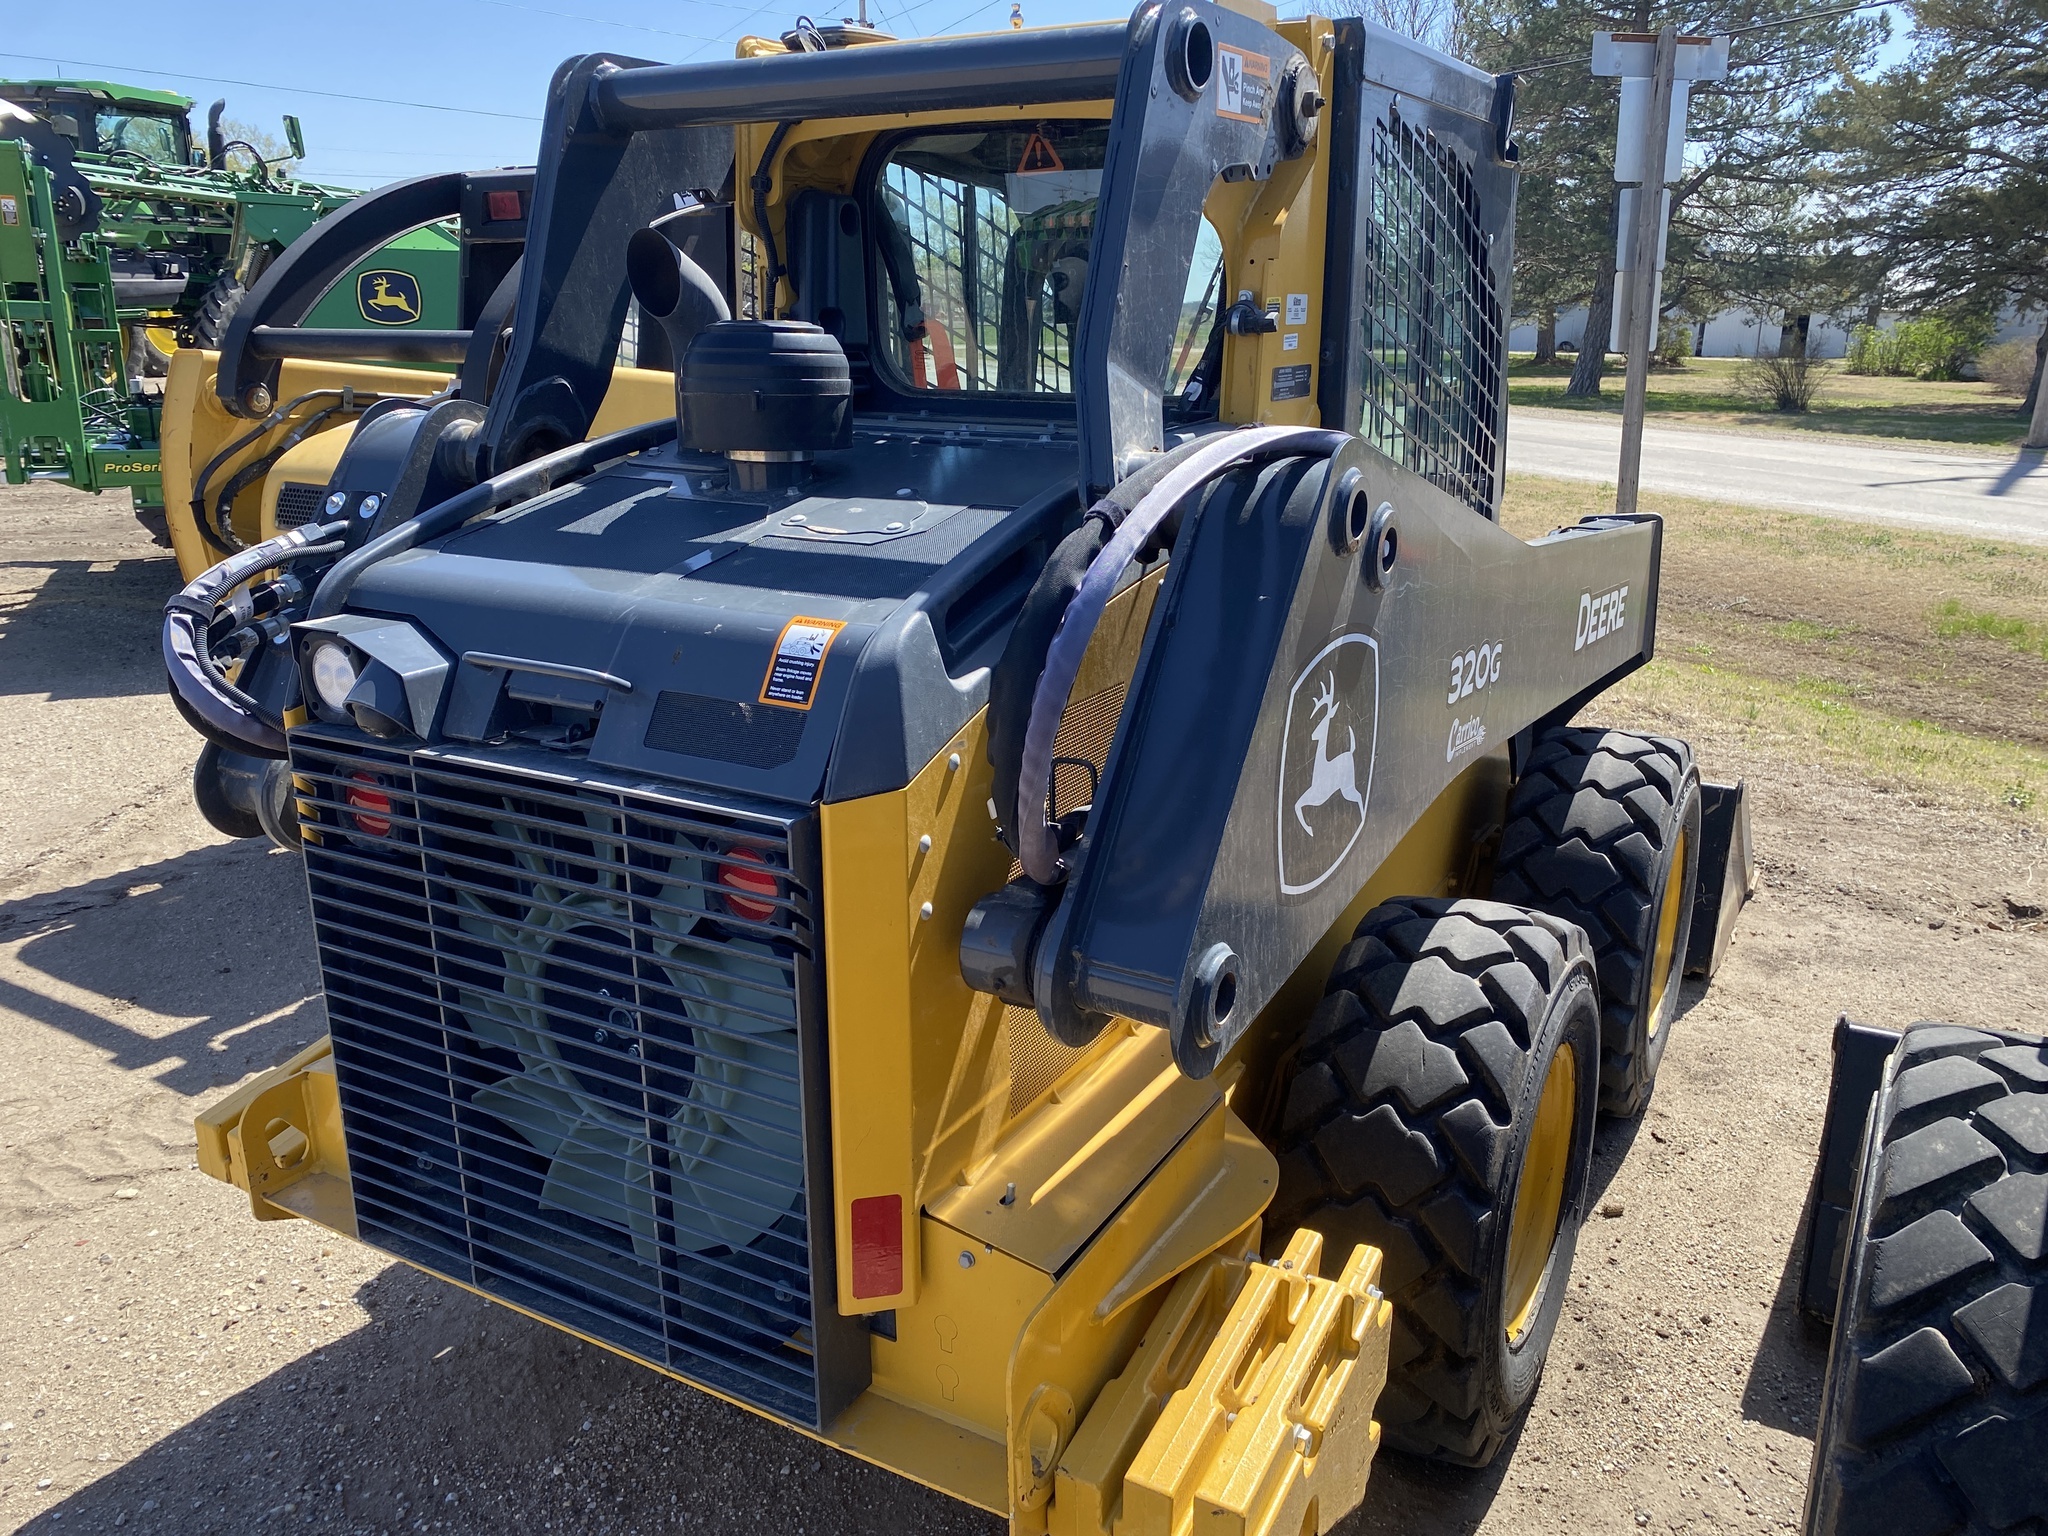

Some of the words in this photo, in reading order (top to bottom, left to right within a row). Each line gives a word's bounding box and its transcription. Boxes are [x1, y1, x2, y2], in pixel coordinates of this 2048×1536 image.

[1243, 82, 1256, 94] Pinch
[1242, 97, 1252, 109] Keep
[104, 462, 162, 473] ProSeri
[804, 619, 842, 629] WARNING
[1574, 585, 1629, 652] DEERE
[1447, 643, 1503, 705] 320G
[1446, 714, 1481, 763] Carrico
